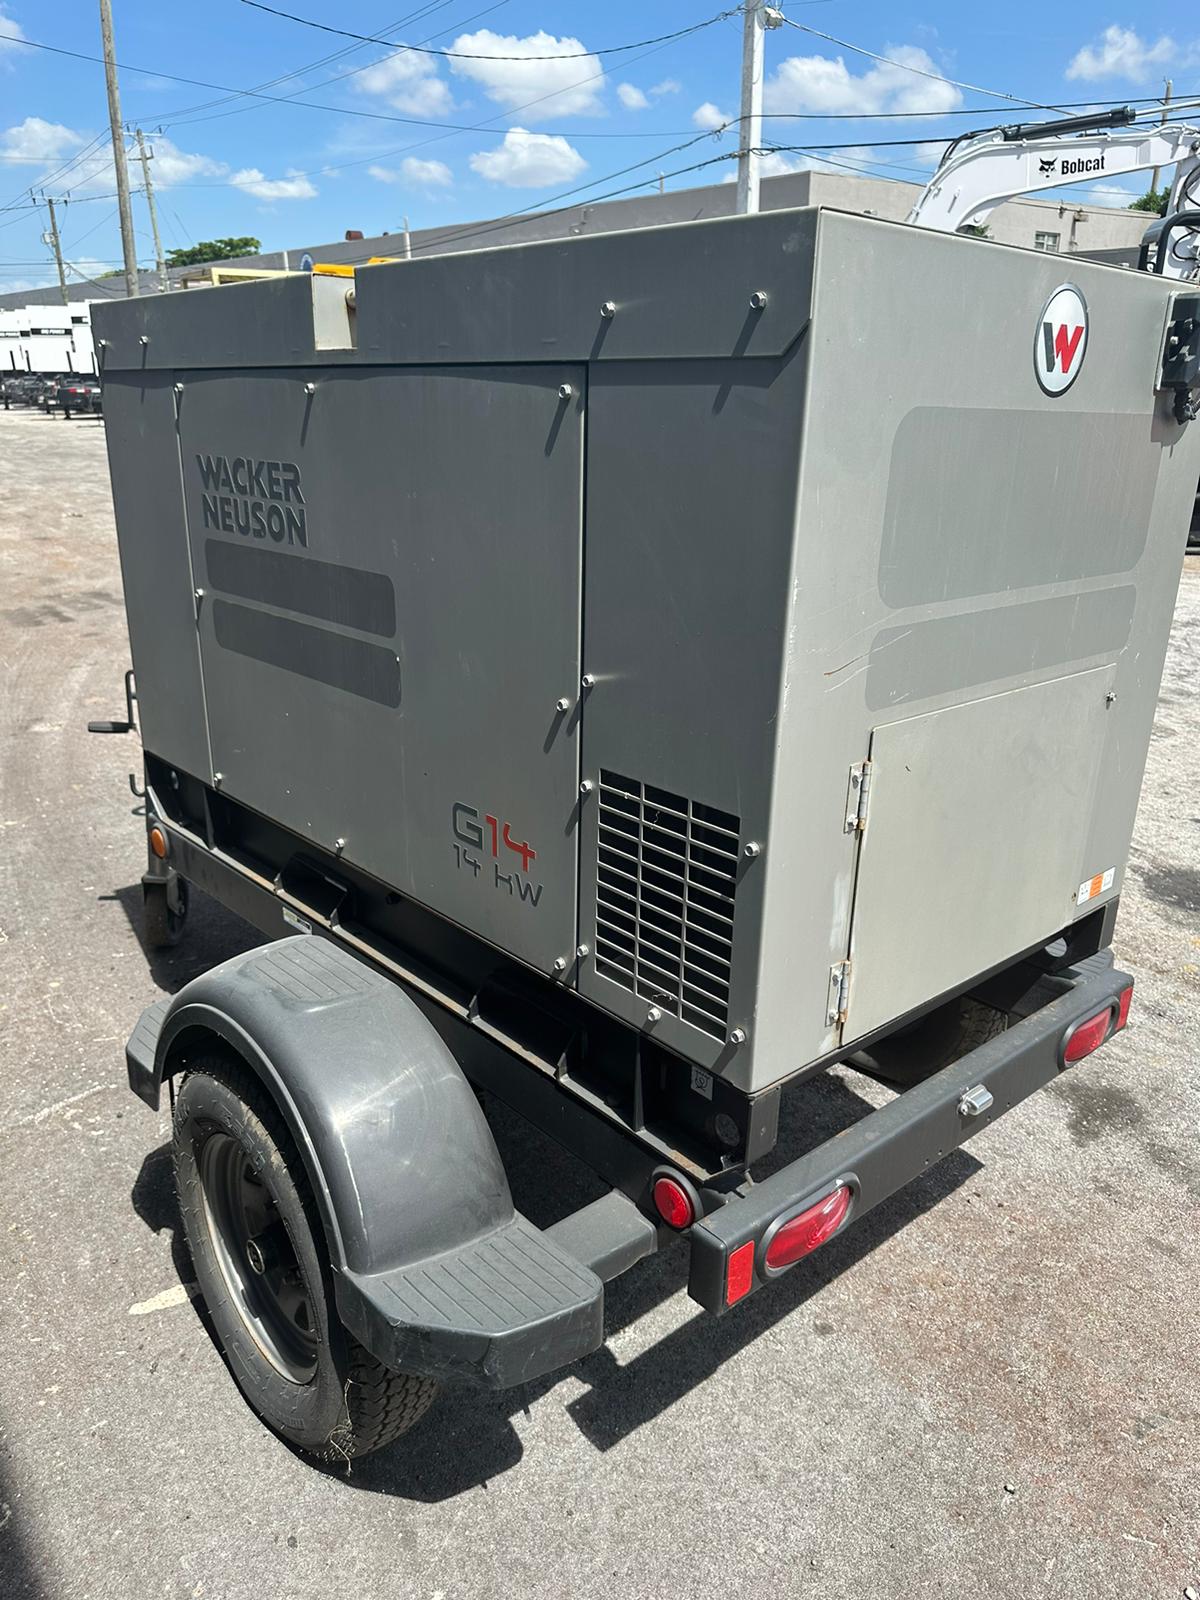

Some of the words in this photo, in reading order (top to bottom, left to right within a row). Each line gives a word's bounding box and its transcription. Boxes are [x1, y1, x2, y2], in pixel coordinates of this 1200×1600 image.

[1061, 155, 1105, 175] Bobcat
[196, 454, 306, 504] WACKER
[202, 493, 309, 547] NEUSON
[452, 801, 537, 873] G14
[453, 842, 482, 878] 14
